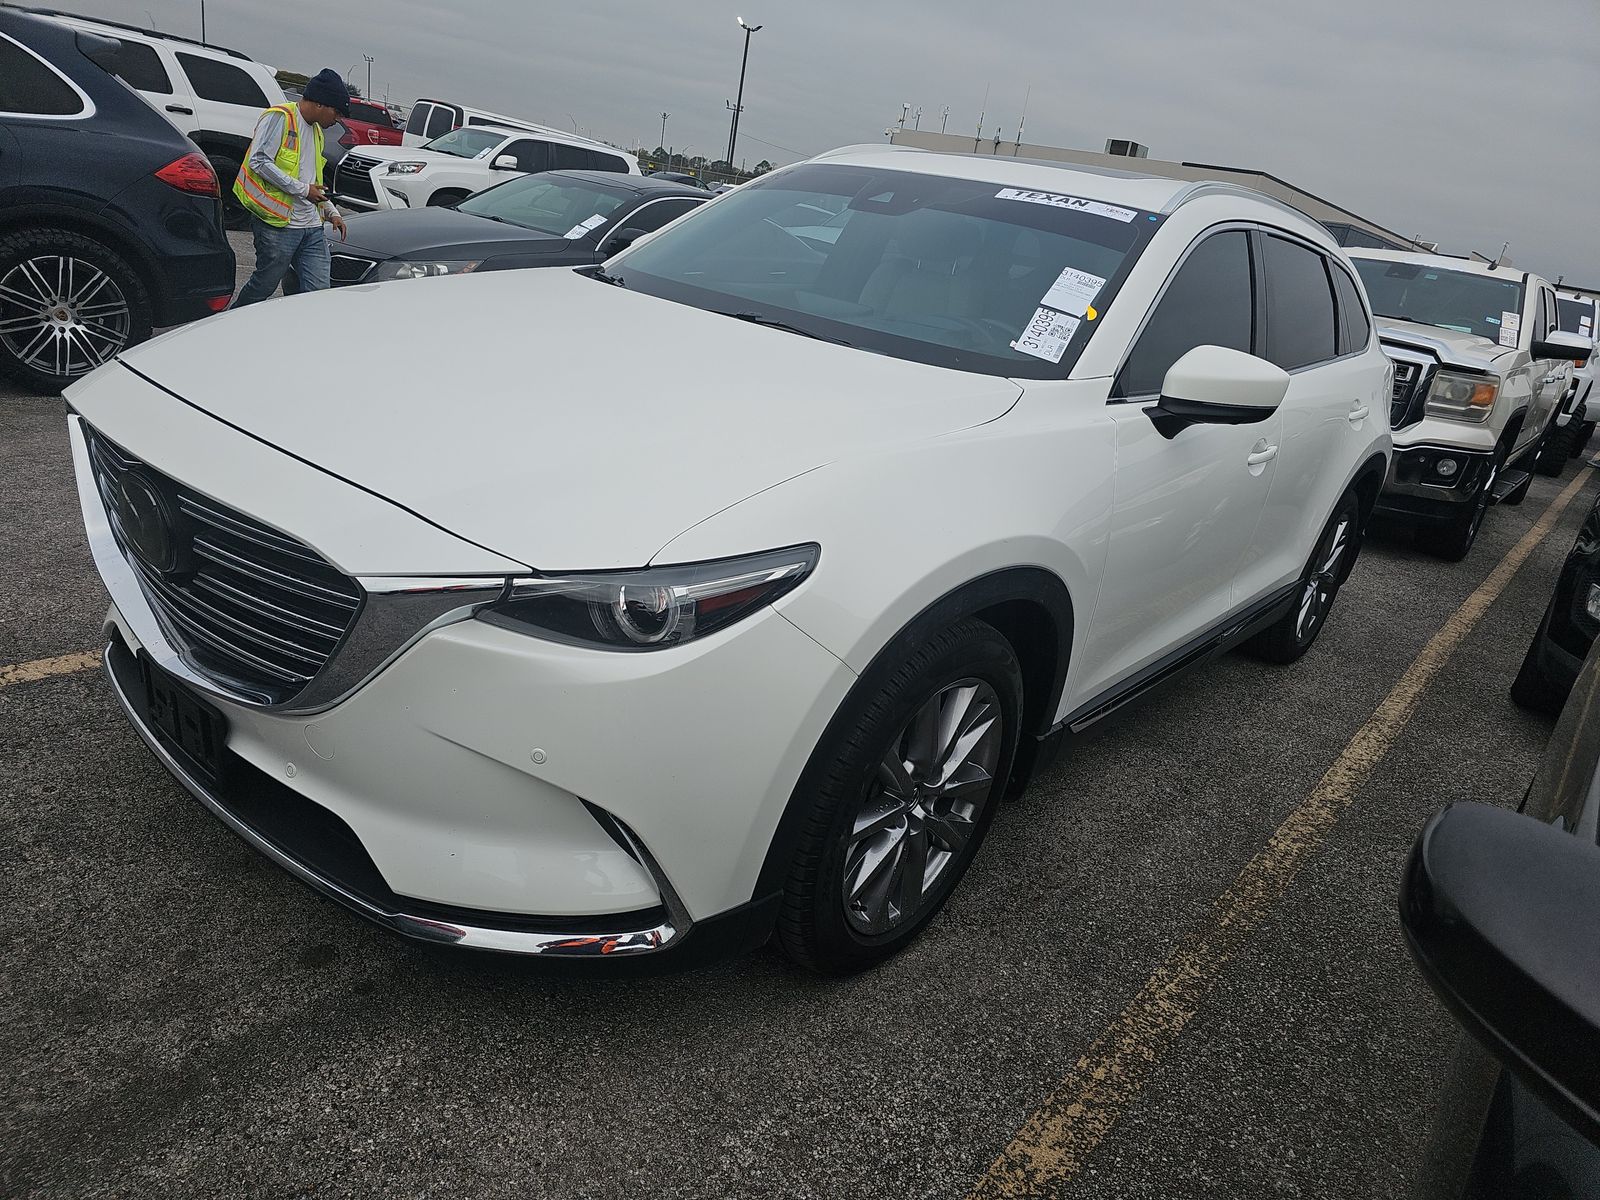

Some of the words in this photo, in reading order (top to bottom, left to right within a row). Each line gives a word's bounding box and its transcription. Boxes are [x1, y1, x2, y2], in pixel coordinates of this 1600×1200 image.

[1014, 190, 1090, 208] TEXAN
[1061, 269, 1104, 288] 3140395
[1022, 308, 1057, 349] 3140395
